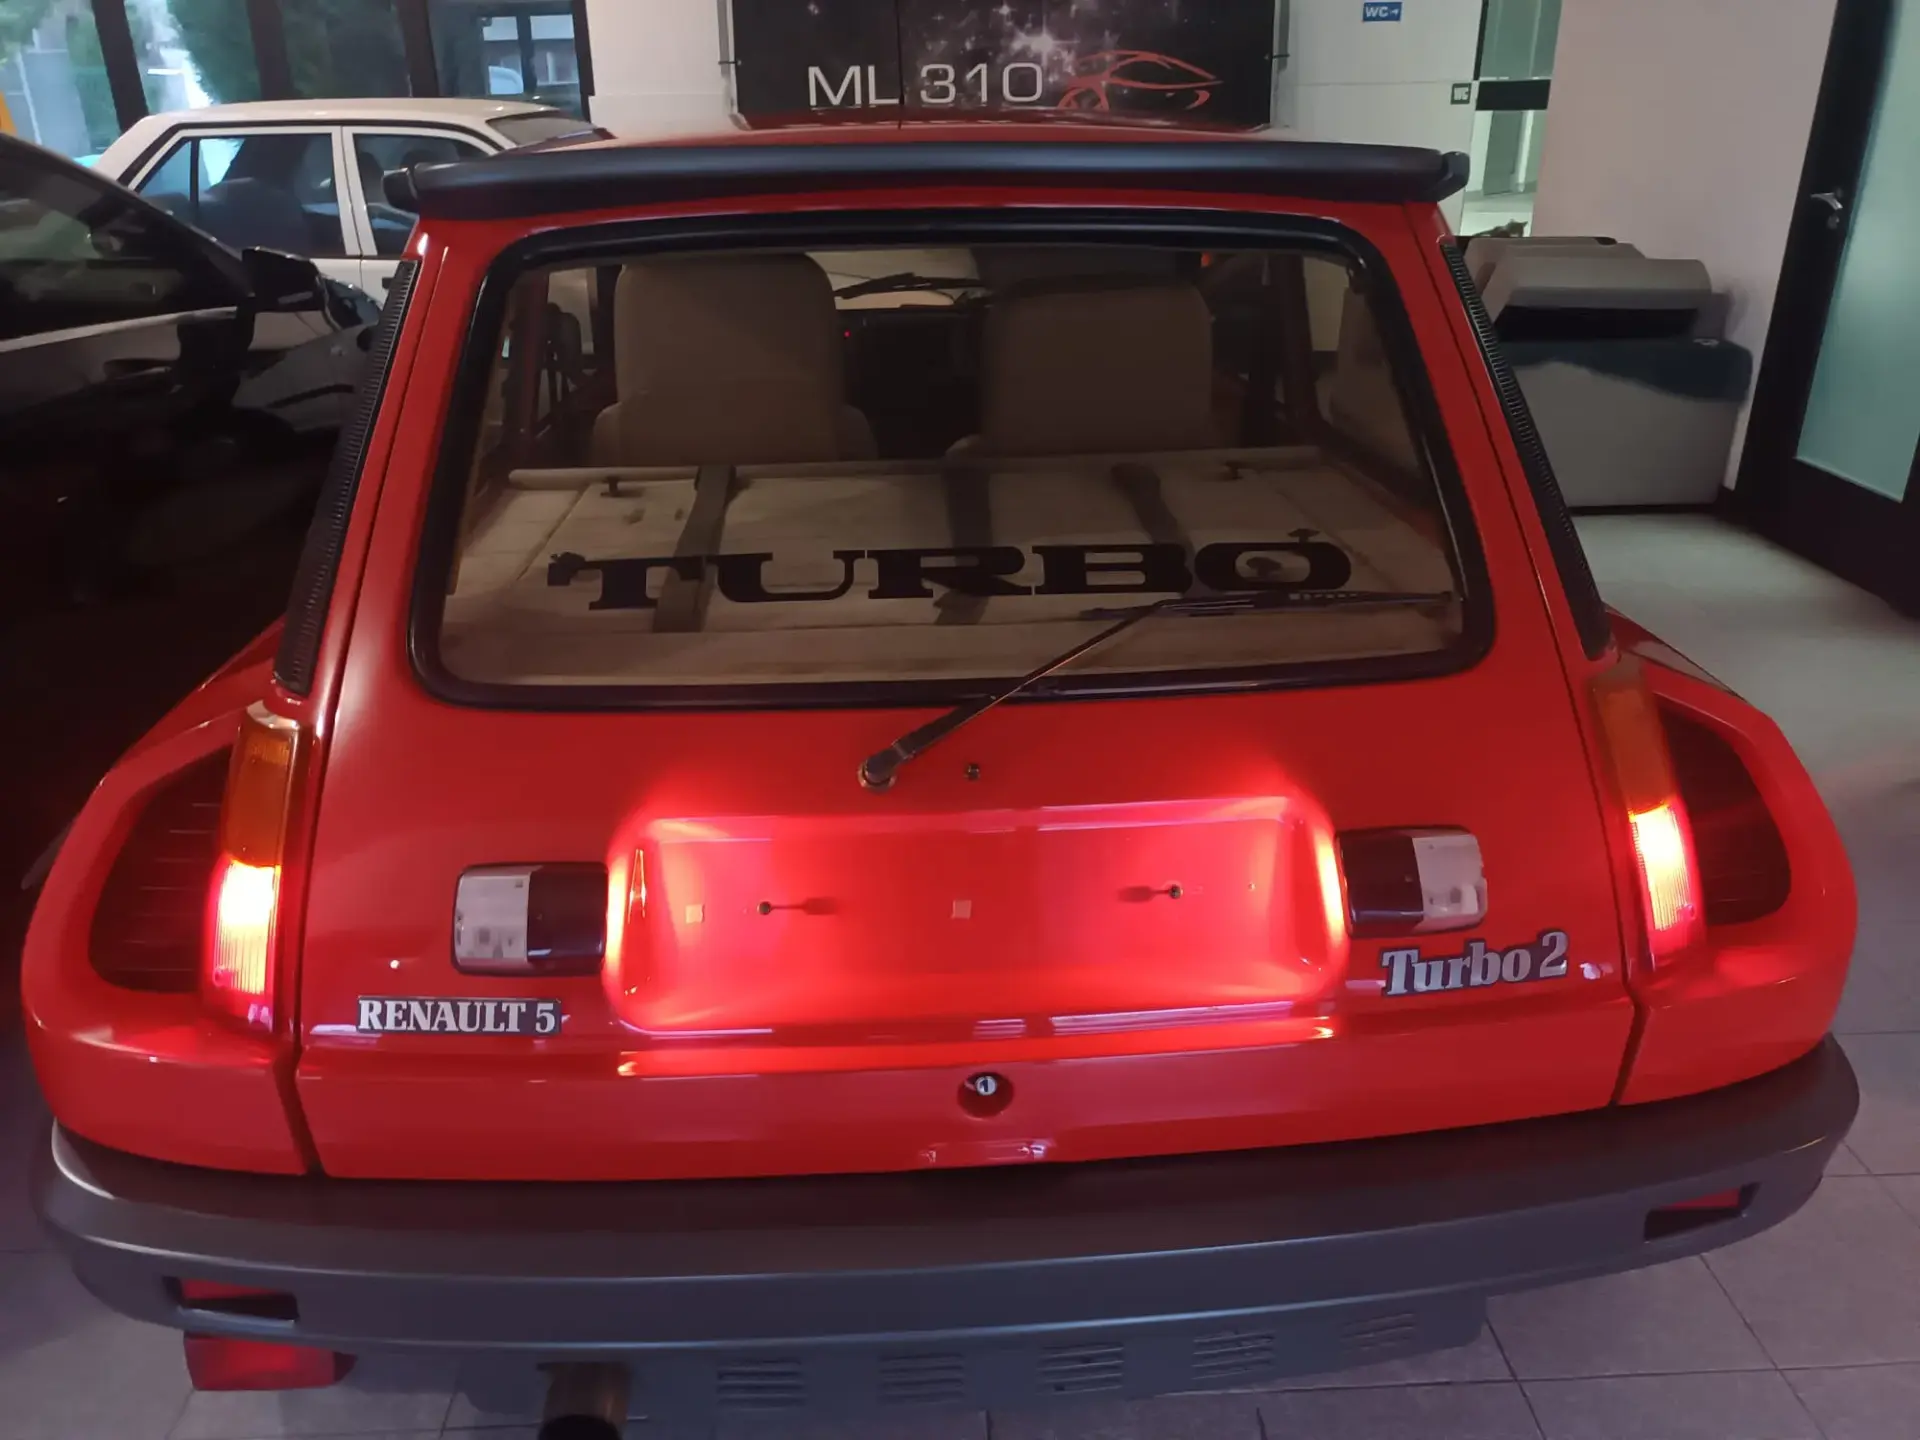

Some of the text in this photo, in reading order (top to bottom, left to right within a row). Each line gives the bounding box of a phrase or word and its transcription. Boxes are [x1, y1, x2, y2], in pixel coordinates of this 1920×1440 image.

[1366, 6, 1388, 17] WC
[807, 63, 1043, 105] ML 310
[547, 542, 1352, 610] TURBO
[1382, 931, 1568, 995] Turbo 2
[359, 1000, 555, 1032] RENAULT 5
